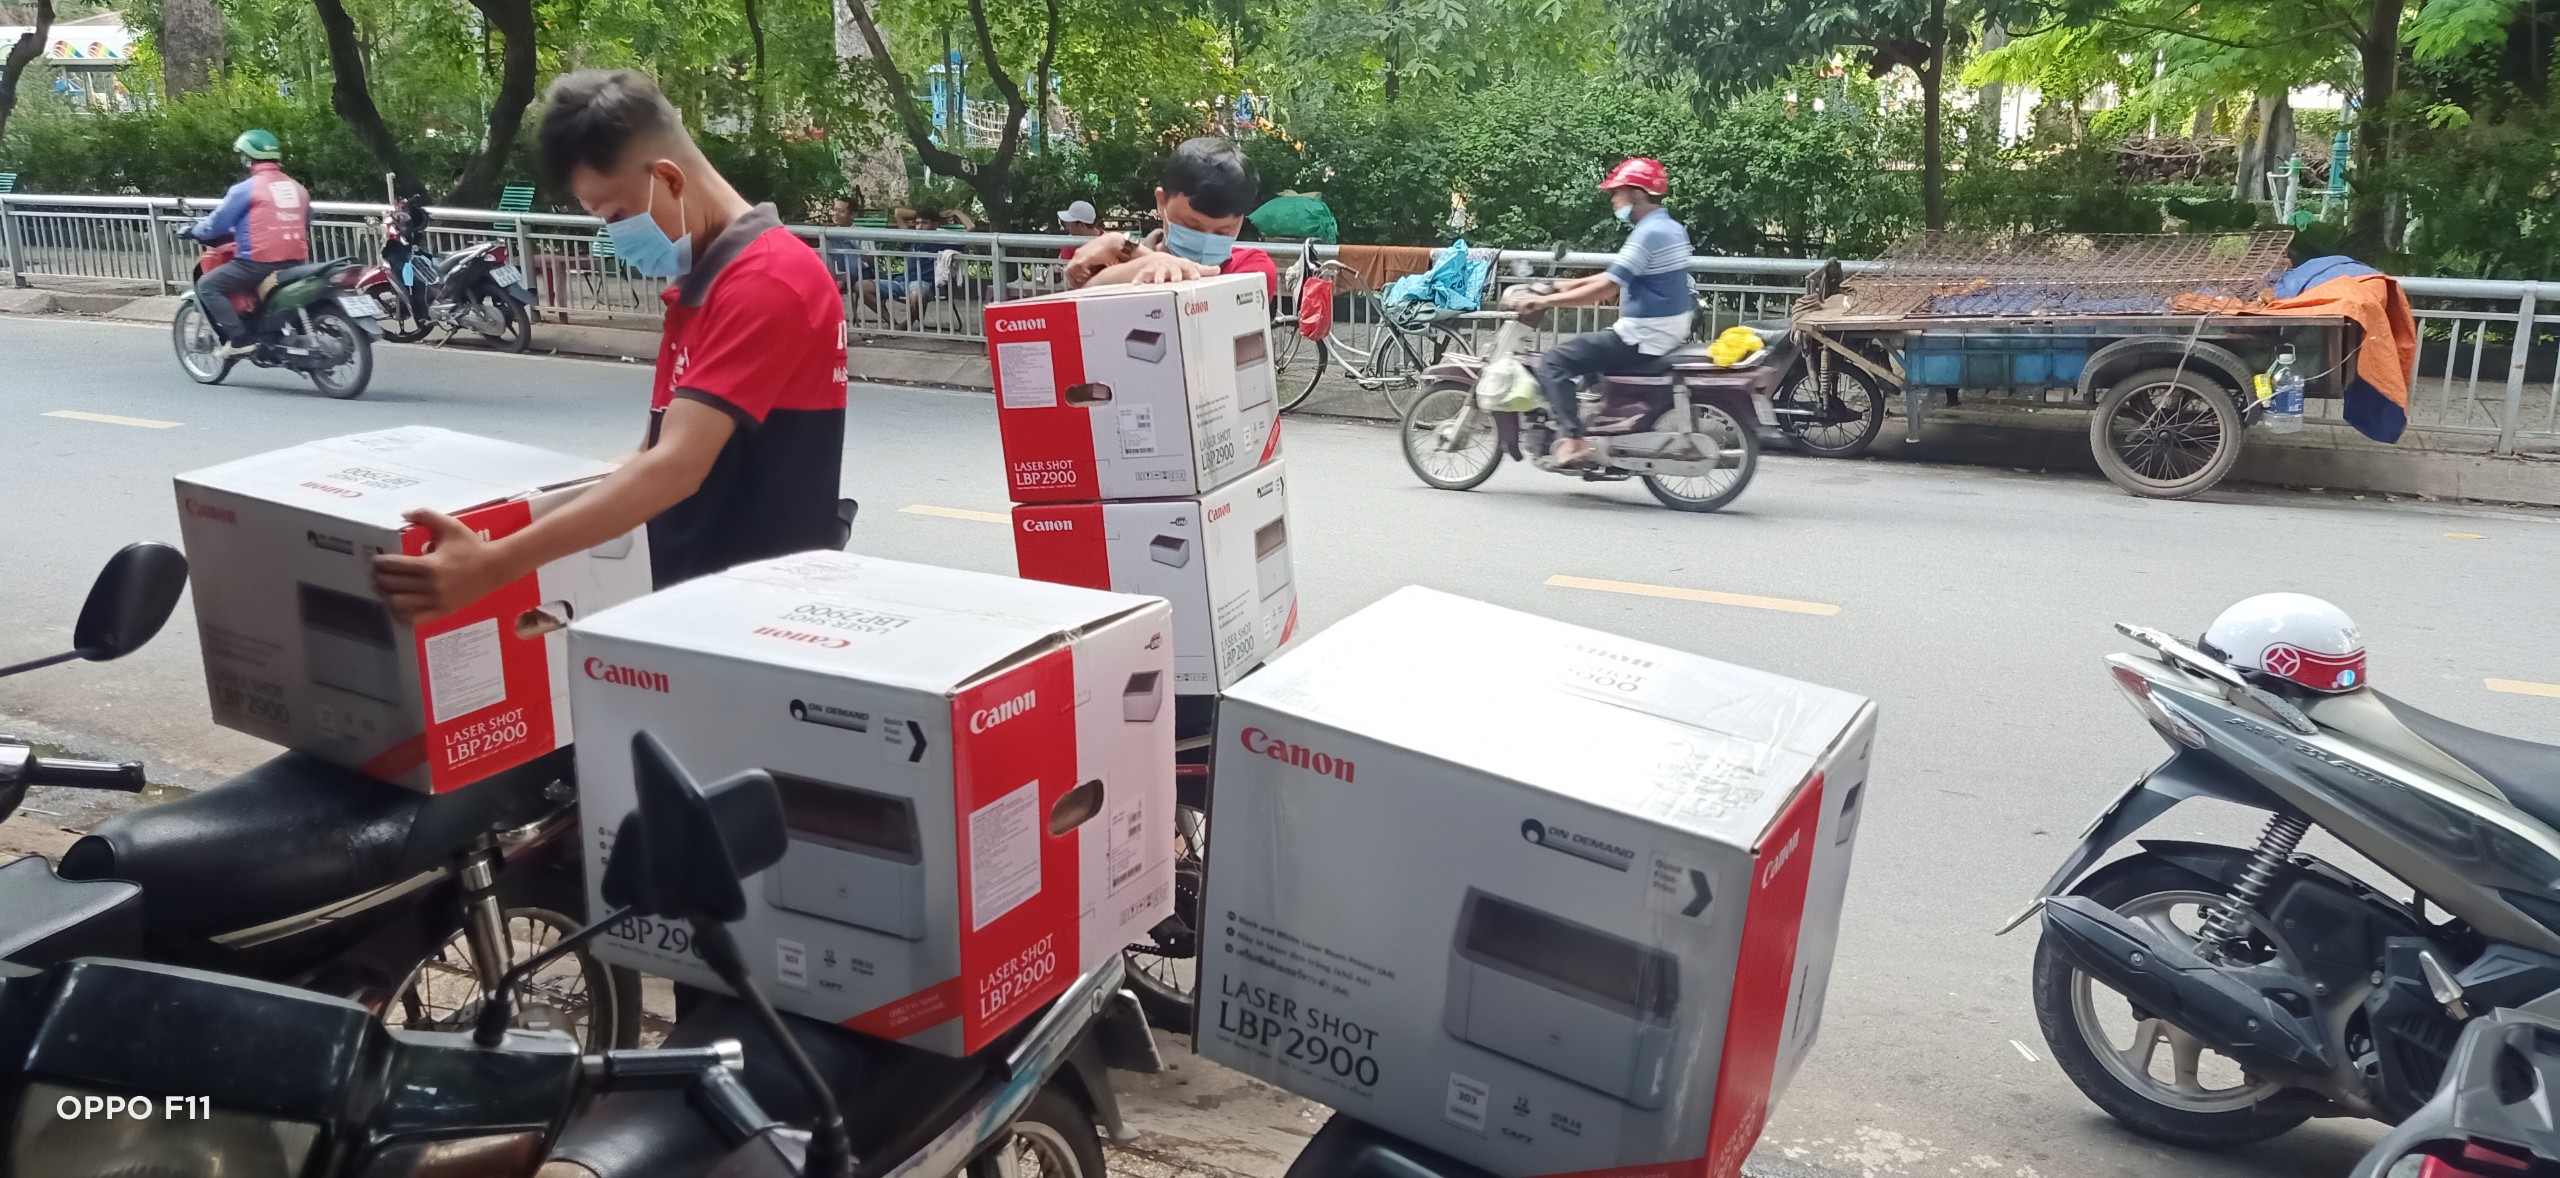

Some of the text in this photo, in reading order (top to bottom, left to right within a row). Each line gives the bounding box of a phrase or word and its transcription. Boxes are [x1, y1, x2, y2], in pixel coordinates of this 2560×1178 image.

[1185, 301, 1209, 316] Canon
[995, 318, 1046, 332] Canon
[1014, 460, 1073, 471] LASER SHOT
[1023, 519, 1073, 532] Canon
[1208, 502, 1231, 523] Canon
[753, 626, 851, 649] Canon
[583, 657, 669, 693] Canon
[445, 708, 523, 746] LASER SHOT
[970, 689, 1037, 734] Canon
[1241, 727, 1355, 783] Canon
[1573, 833, 1635, 860] DEMAND
[1762, 827, 1800, 890] Canon
[980, 933, 1053, 994] LASER SHOT
[1222, 974, 1379, 1050] LASER SHOT
[1219, 1000, 1379, 1087] LBP2900
[1458, 1091, 1477, 1105] 303
